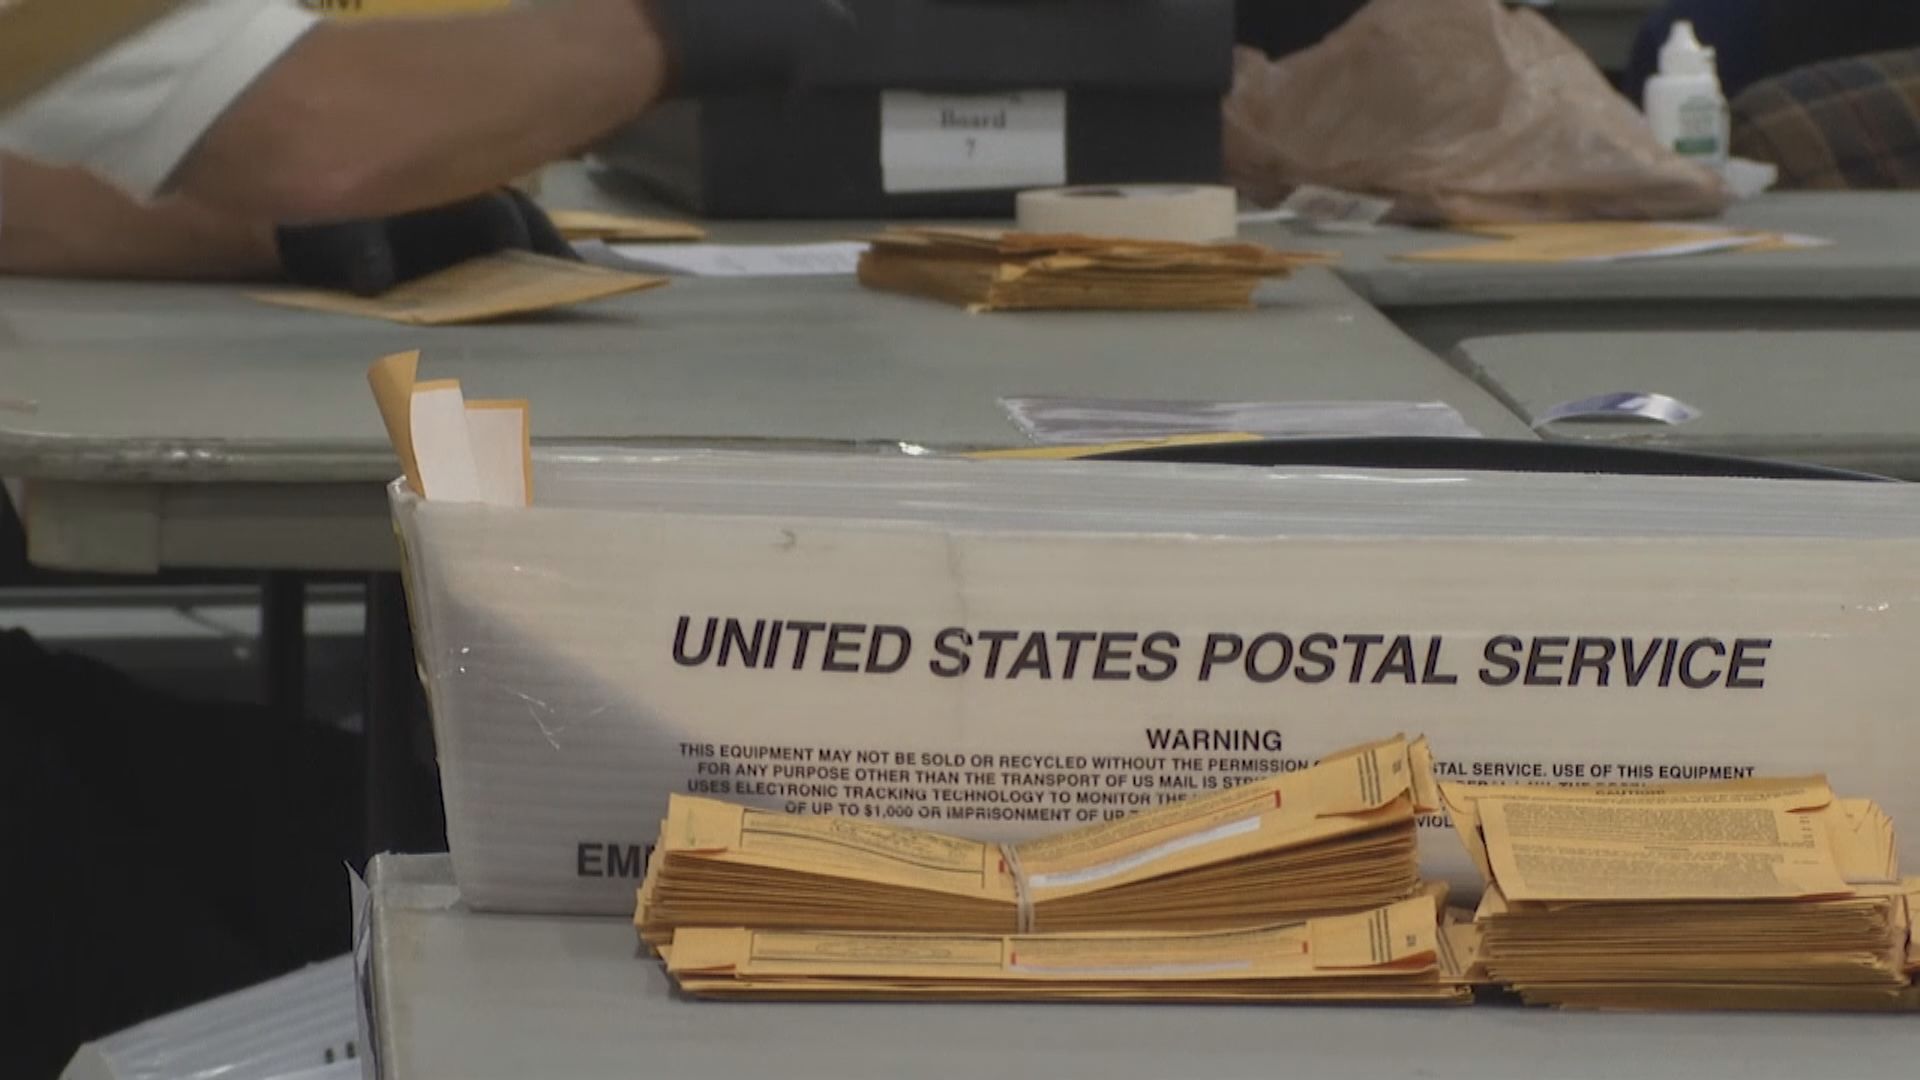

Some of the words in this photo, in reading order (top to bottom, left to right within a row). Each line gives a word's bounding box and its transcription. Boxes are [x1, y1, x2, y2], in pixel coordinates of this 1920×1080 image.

[940, 109, 1007, 129] Board
[672, 615, 912, 675] UNITED
[928, 627, 1181, 681] STATES
[1198, 631, 1458, 685] POSTAL
[1478, 636, 1772, 689] SERVICE
[1146, 728, 1283, 751] WARNING
[680, 743, 715, 757] THIS
[720, 744, 814, 761] EQUIPMENT
[819, 748, 852, 763] MAY
[857, 750, 890, 764] NOT
[895, 752, 917, 766] BE
[921, 753, 966, 768] SOLD
[970, 754, 994, 768] OR
[999, 755, 1087, 770] RECYCLED
[1092, 756, 1166, 771] WITHOUT
[1172, 758, 1203, 772] THE
[1208, 758, 1308, 773] PERMISSION
[1433, 762, 1468, 775] TAL
[1472, 762, 1548, 777] SERVICE.
[1553, 764, 1585, 777] USE
[1590, 764, 1613, 777] OF
[1617, 764, 1654, 779] THIS
[1659, 765, 1755, 780] EQUIPMENT
[697, 762, 731, 776] FOR
[735, 763, 768, 777] ANY
[773, 765, 850, 781] PURPOSE
[855, 768, 910, 783] OTHER
[915, 770, 960, 785] THAN
[964, 772, 996, 786] THE
[1001, 773, 1100, 788] TRANSPORT
[1105, 774, 1128, 788] OF
[1132, 775, 1154, 788] US
[1159, 775, 1198, 789] MAIL
[1202, 776, 1218, 789] IS
[687, 779, 731, 794] USES
[735, 781, 838, 798] ELECTRONIC
[843, 785, 927, 801] TRACKING
[932, 788, 1045, 804] TECHNOLOGY
[1049, 790, 1071, 804] TO
[1076, 791, 1151, 806] MONITOR
[785, 801, 807, 814] OF
[811, 802, 833, 815] UP
[838, 803, 860, 817] TO
[864, 804, 914, 820] $1,000
[918, 806, 942, 819] OR
[946, 806, 1072, 822] IMPRISONMENT
[1076, 808, 1098, 822] OF
[1103, 809, 1125, 822] UP
